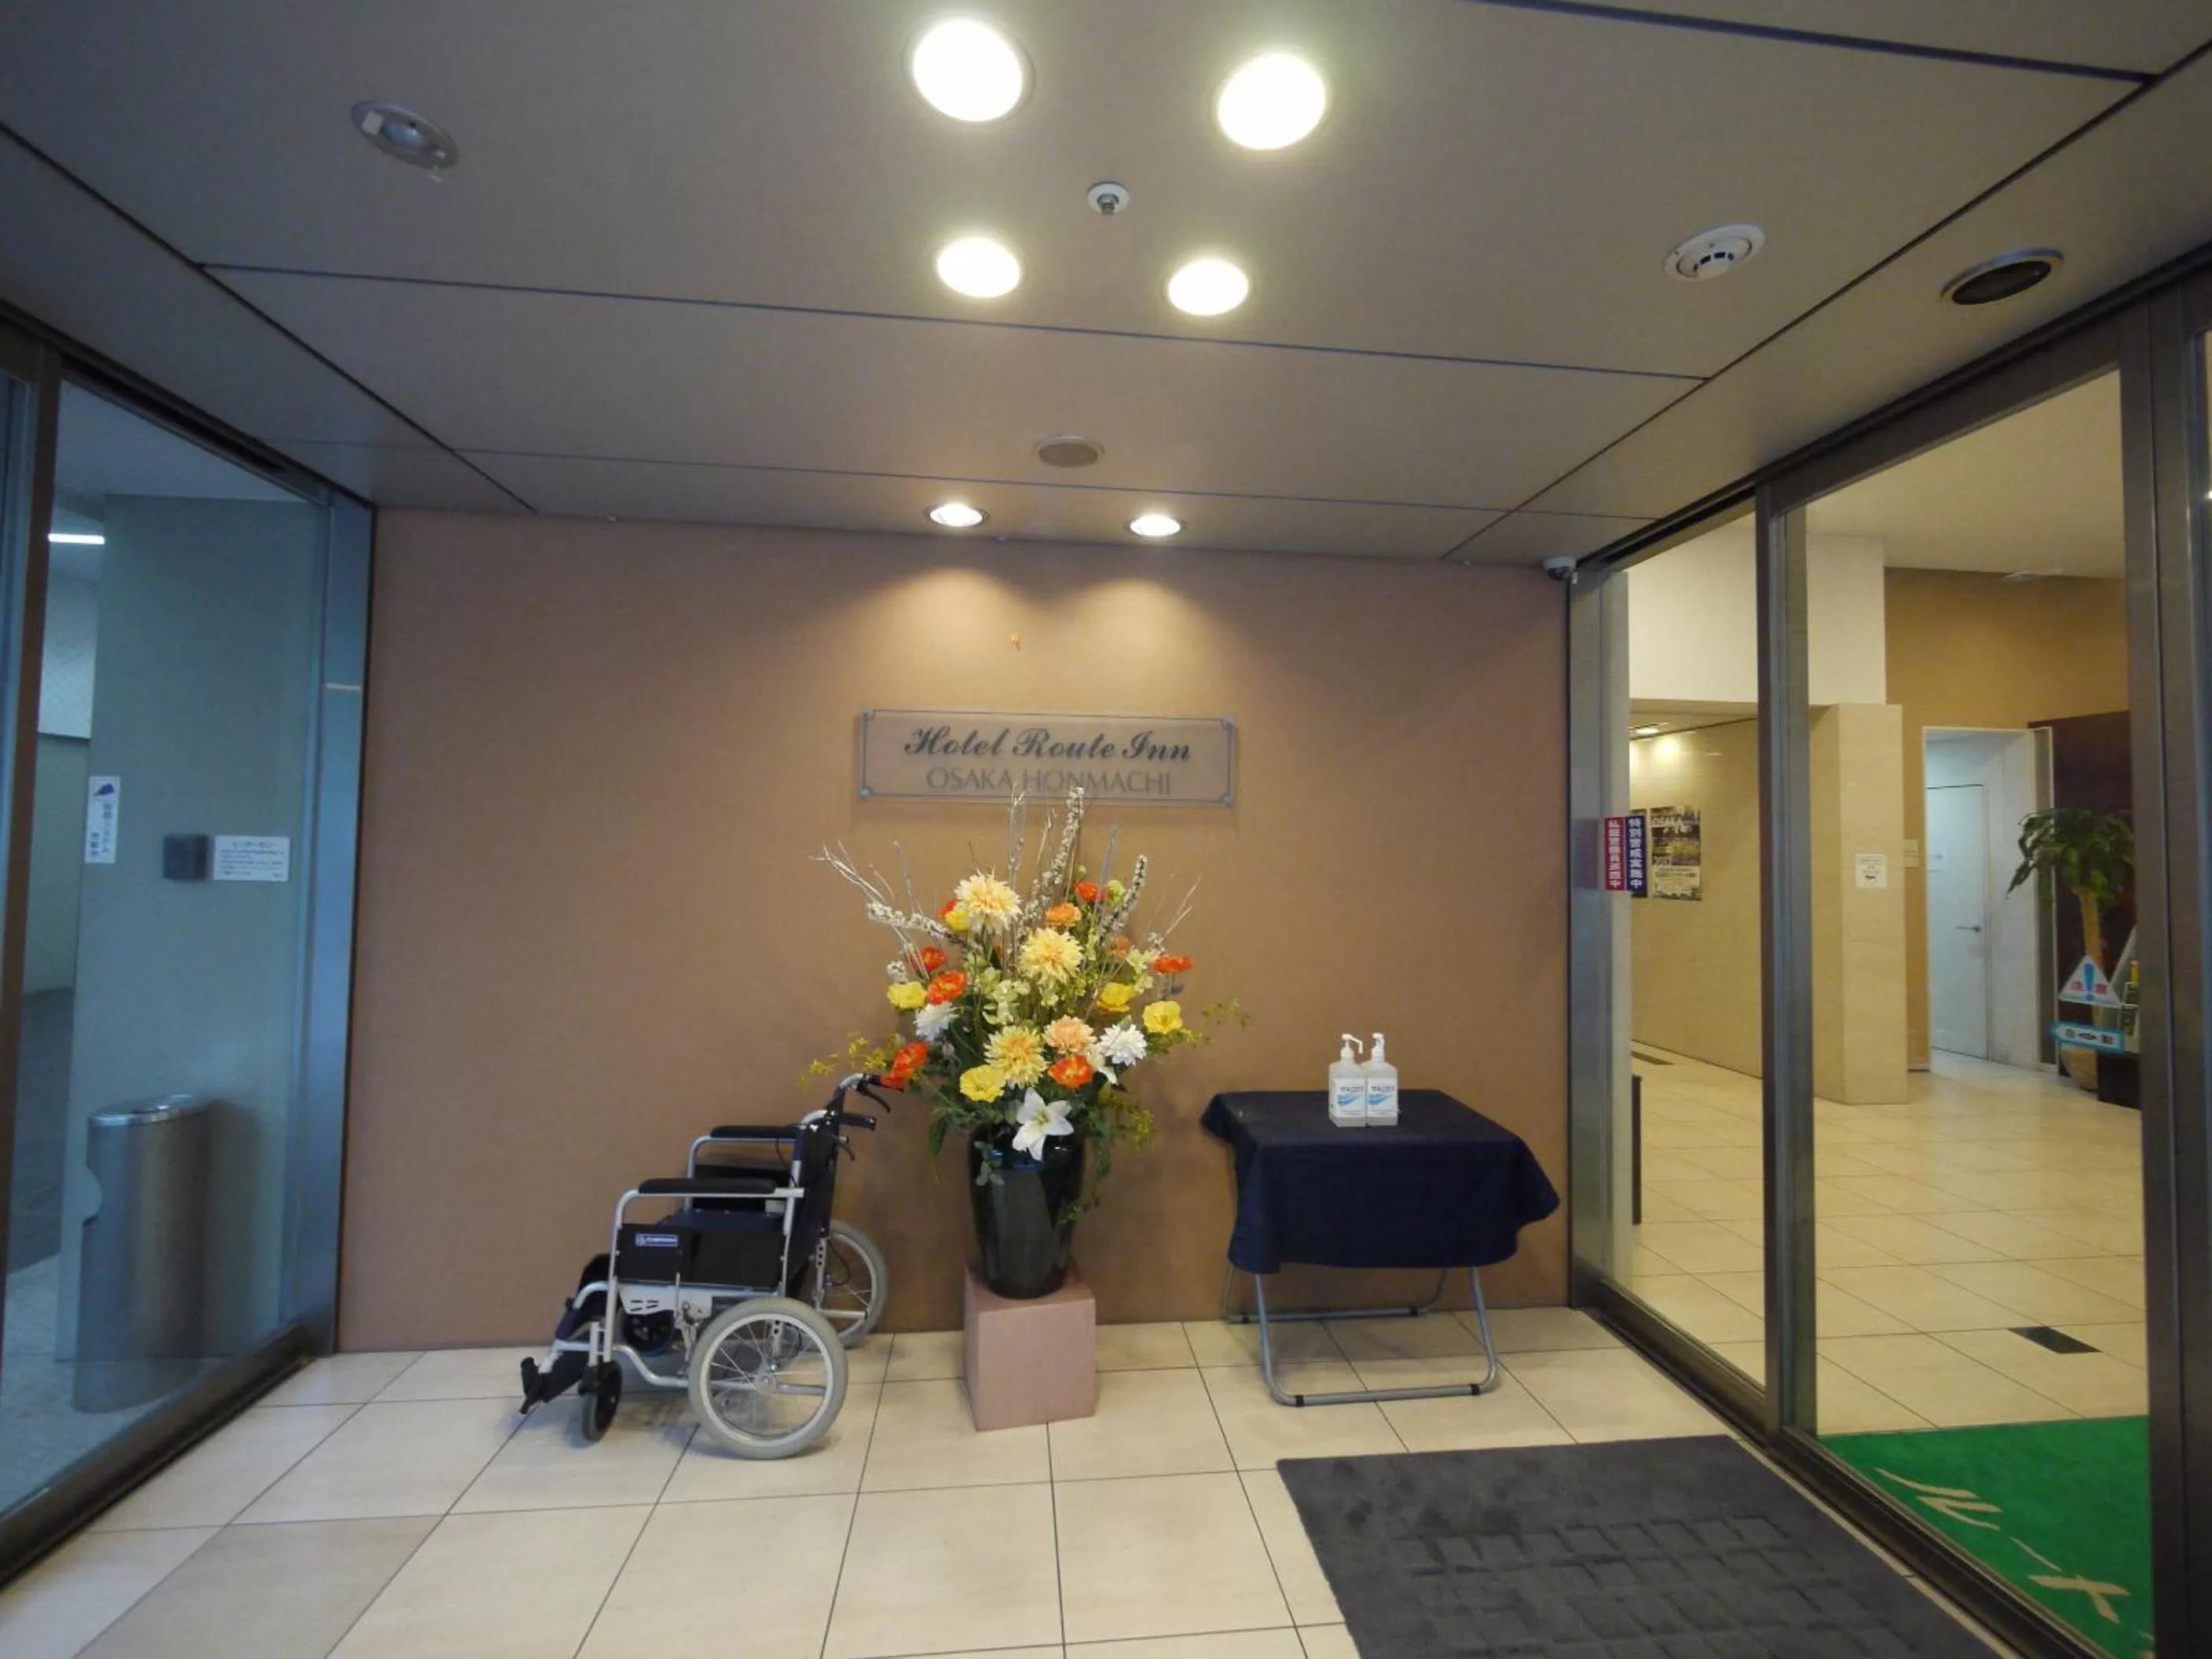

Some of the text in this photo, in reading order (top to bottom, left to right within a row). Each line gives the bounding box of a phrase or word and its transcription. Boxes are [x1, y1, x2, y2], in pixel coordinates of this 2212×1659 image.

[904, 725, 1191, 761] Hotel Route Inn
[926, 766, 1170, 795] OSAKA HONMACHI
